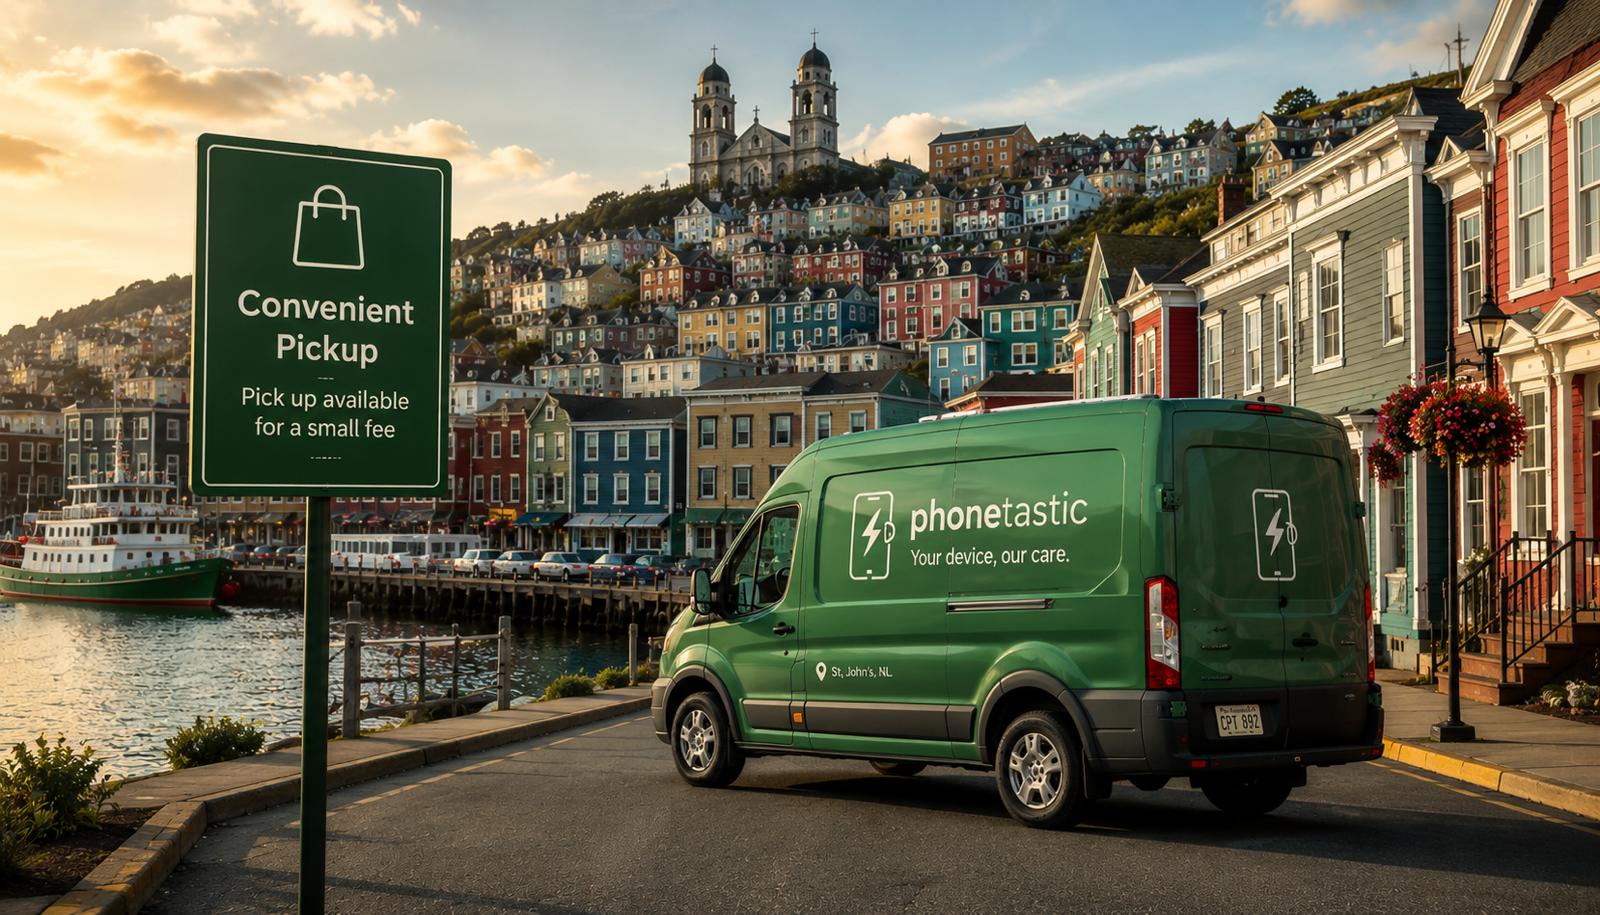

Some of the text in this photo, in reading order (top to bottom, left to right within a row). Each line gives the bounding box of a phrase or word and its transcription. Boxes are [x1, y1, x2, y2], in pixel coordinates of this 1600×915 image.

[237, 289, 415, 325] Convenient
[276, 333, 379, 369] Pickup
[241, 387, 410, 411] Pick up available
[255, 416, 396, 439] for a small fee
[910, 490, 1089, 541] phonetastic
[910, 547, 1070, 567] Your device, our care.
[846, 666, 877, 677] John's,
[1220, 714, 1260, 730] CPT 892
